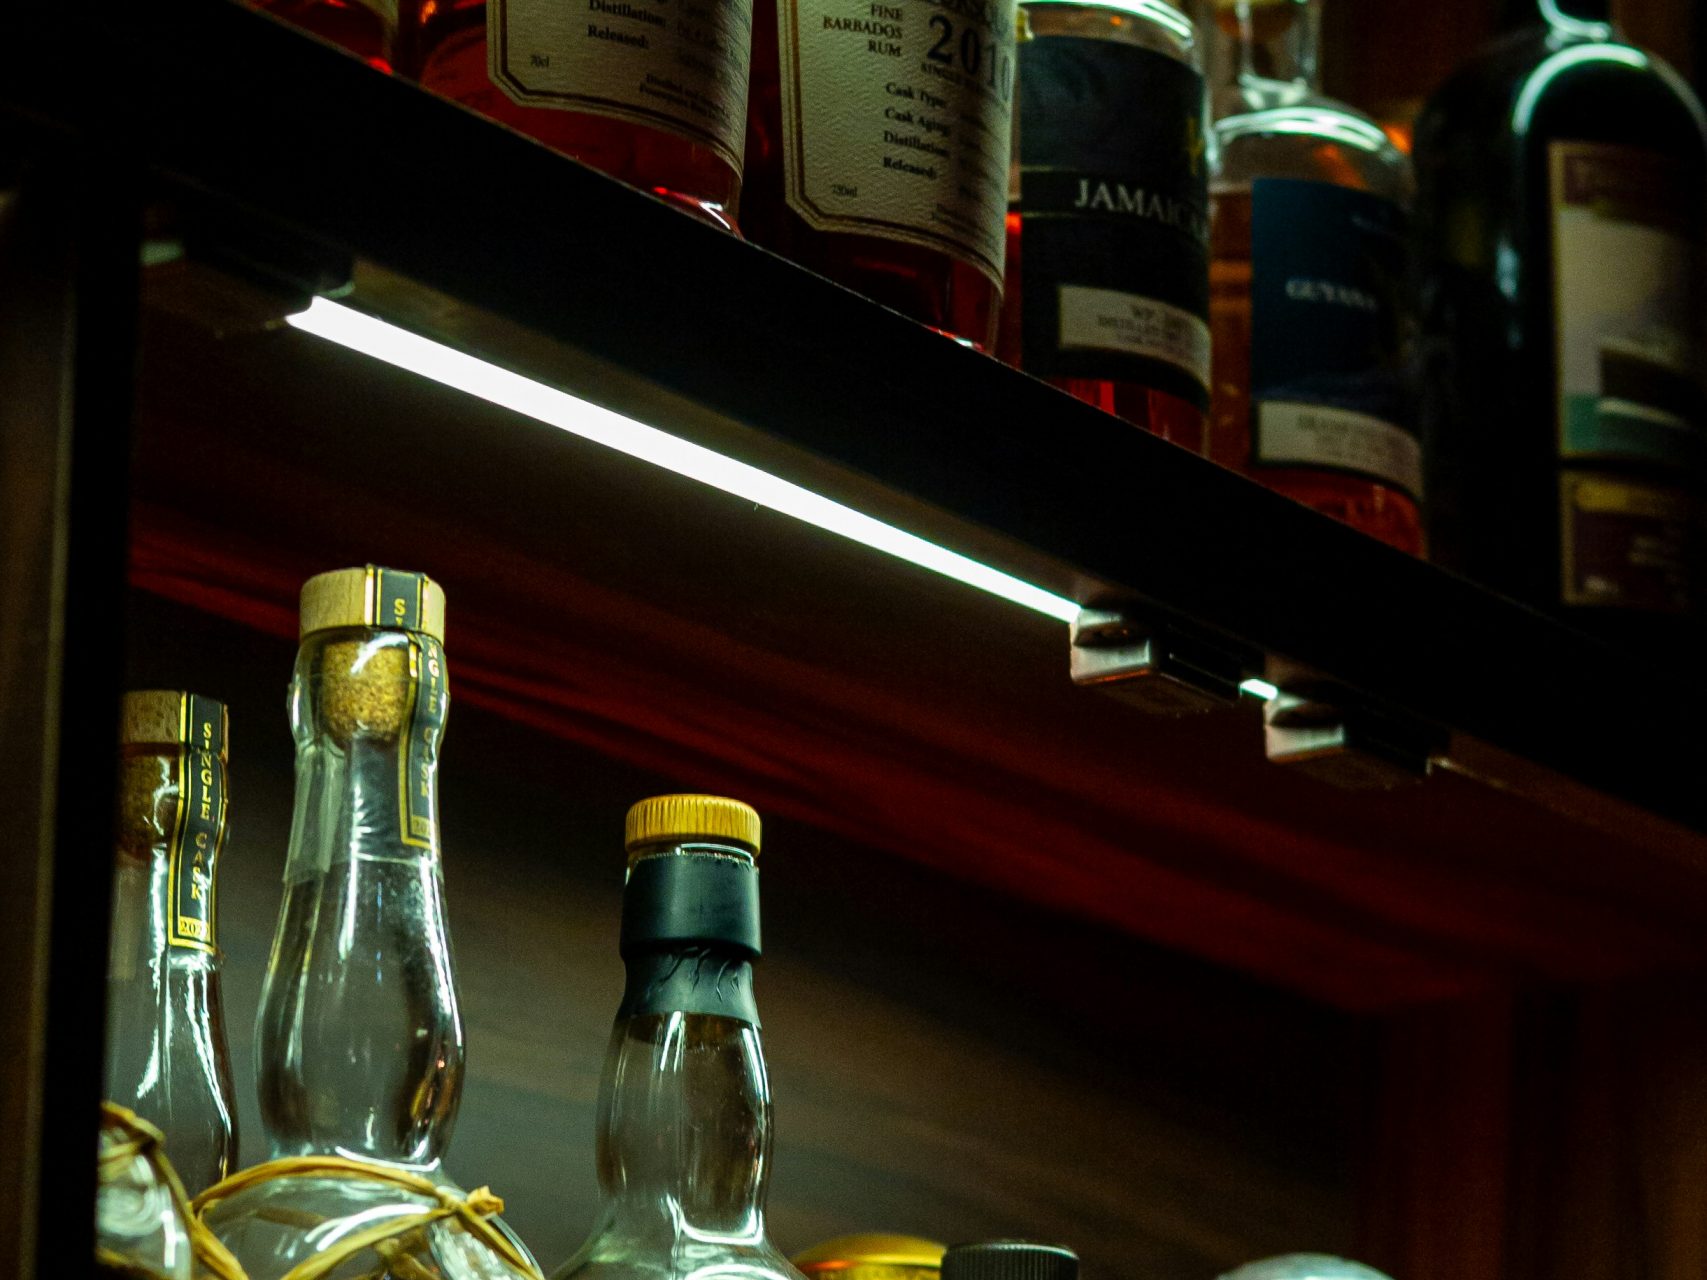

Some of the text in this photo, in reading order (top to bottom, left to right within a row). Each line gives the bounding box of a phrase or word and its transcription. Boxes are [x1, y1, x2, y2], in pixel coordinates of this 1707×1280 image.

[871, 4, 903, 20] FINE
[823, 16, 903, 38] BARBADOS
[868, 40, 901, 56] RUM
[927, 15, 1010, 101] 2010
[885, 82, 914, 99] Cask
[885, 107, 914, 124] Cask
